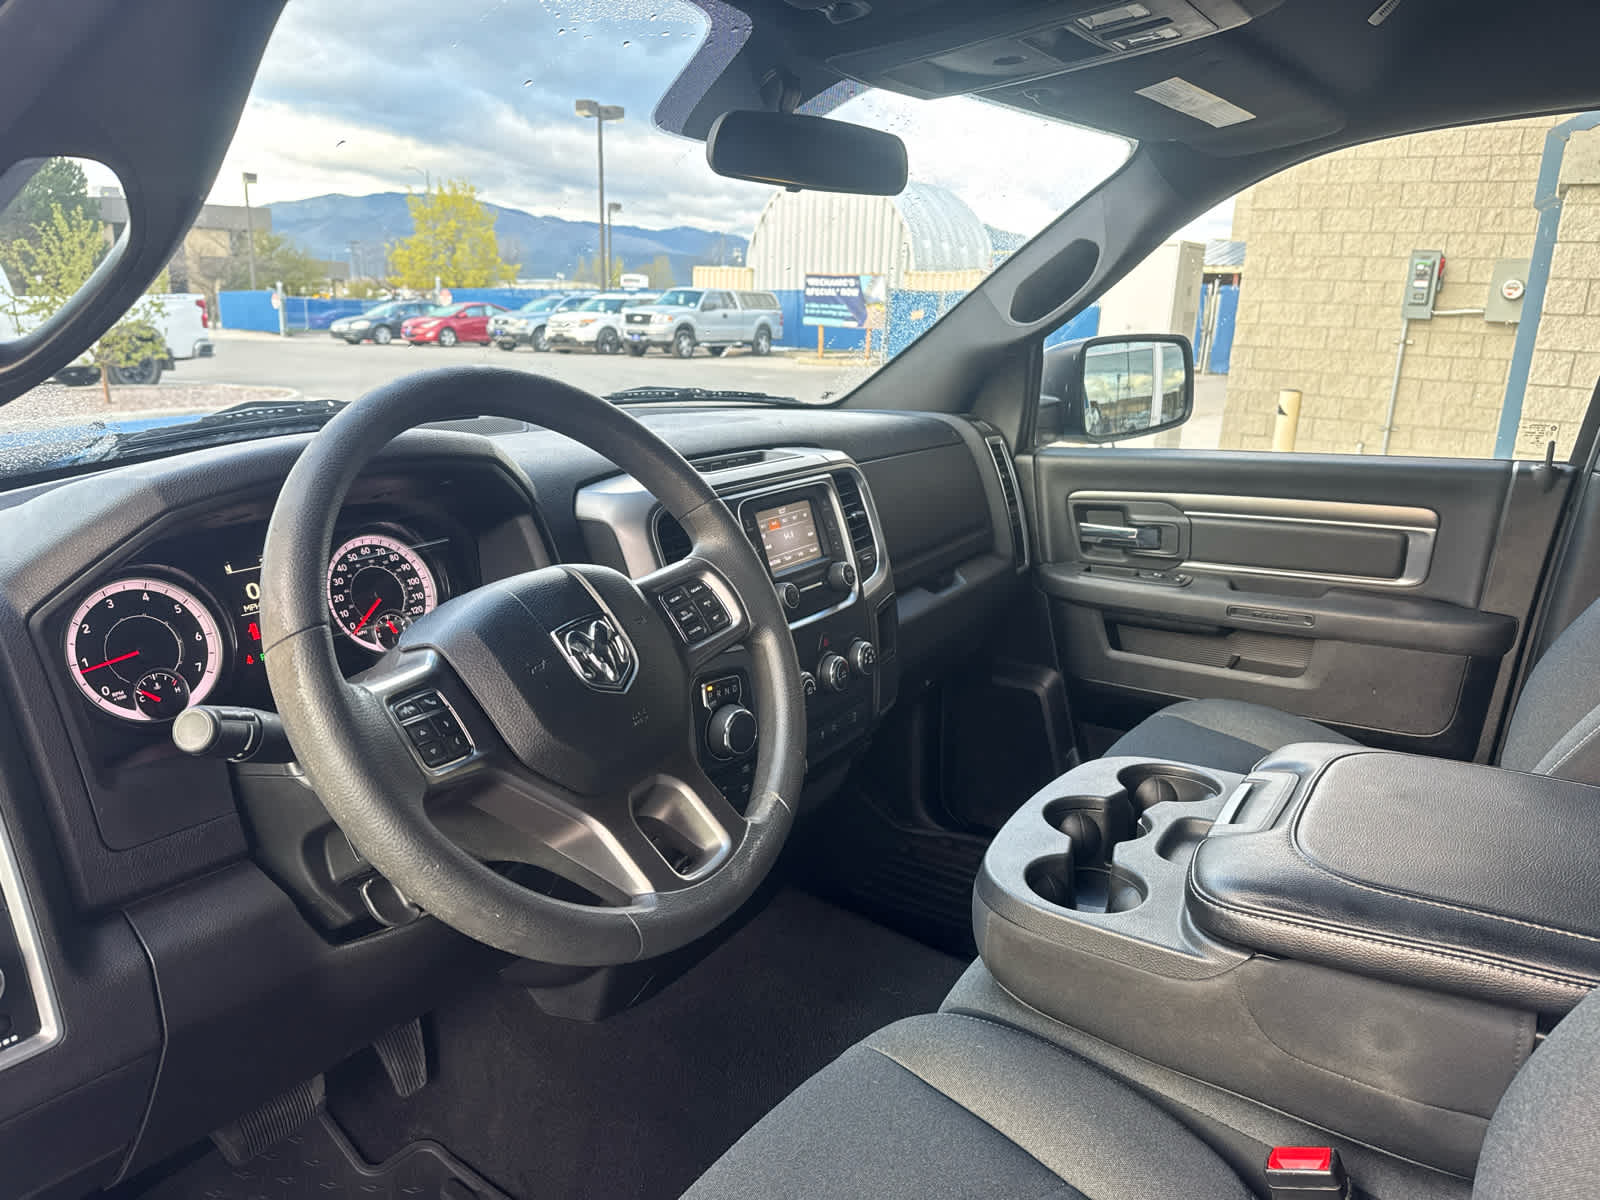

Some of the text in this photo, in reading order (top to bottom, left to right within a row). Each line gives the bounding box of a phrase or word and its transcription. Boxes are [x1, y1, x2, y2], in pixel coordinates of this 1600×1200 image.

[360, 547, 371, 555] 60
[375, 548, 386, 556] 70
[347, 553, 358, 562] 50
[389, 553, 400, 562] 80
[336, 563, 348, 572] 40
[400, 562, 411, 571] 90
[332, 577, 344, 586] 30
[407, 577, 420, 586] 100
[245, 582, 260, 600] 0
[142, 592, 150, 601] 4
[333, 594, 345, 603] 20
[411, 591, 424, 601] 110
[105, 599, 115, 609] 3
[174, 604, 182, 614] 5
[339, 609, 350, 618] 10
[410, 605, 424, 614] 120
[81, 623, 91, 635] 2
[349, 622, 356, 630] 0
[195, 631, 203, 641] 6
[81, 657, 89, 668] 1
[194, 662, 202, 672] 7
[101, 685, 111, 697] 0
